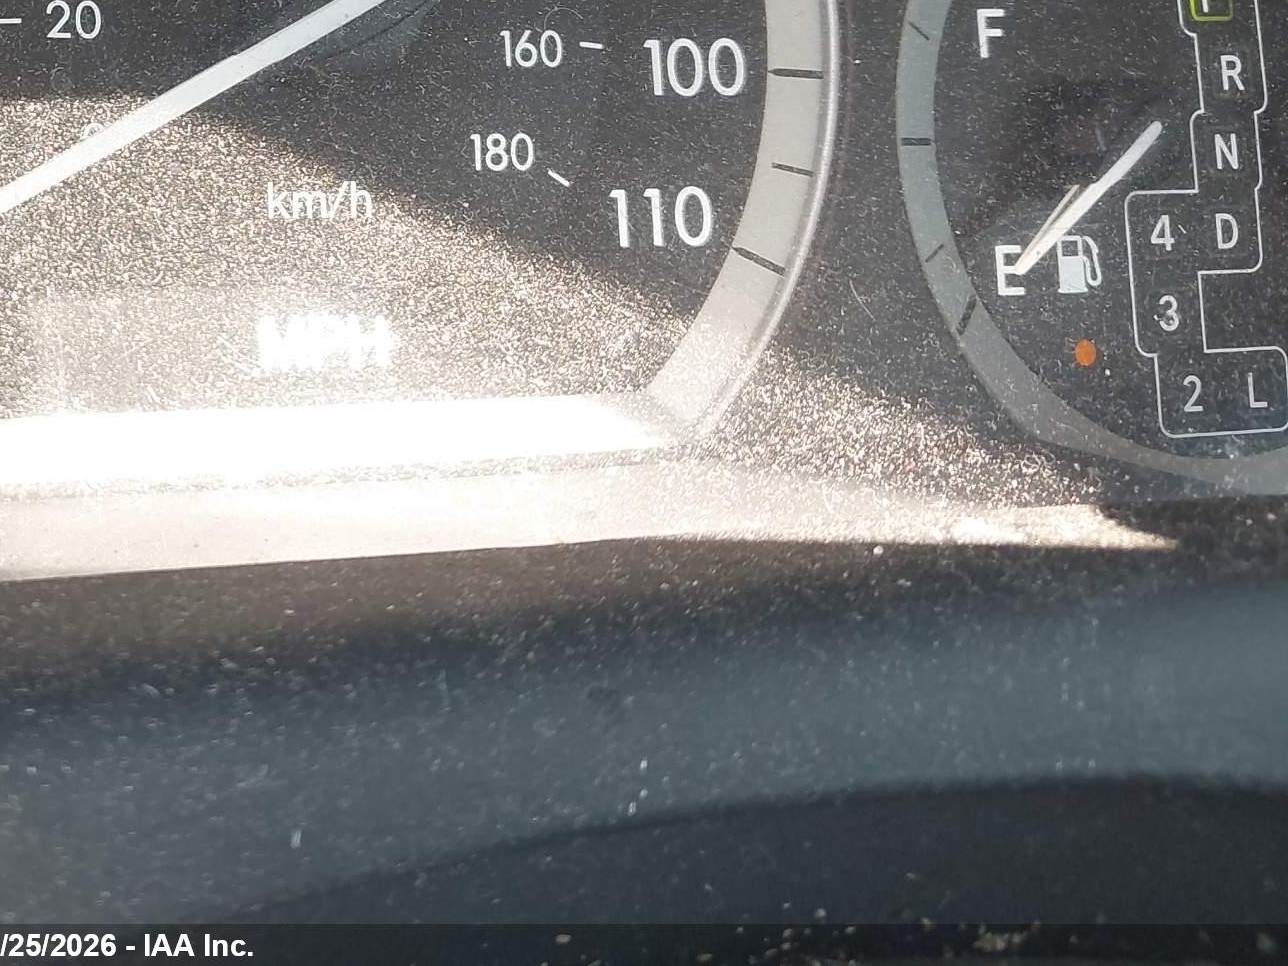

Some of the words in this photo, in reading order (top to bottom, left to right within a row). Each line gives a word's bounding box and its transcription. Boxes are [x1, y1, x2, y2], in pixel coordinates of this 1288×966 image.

[45, 0, 102, 39] 20
[977, 8, 1006, 58] F
[500, 30, 563, 68] 160
[643, 37, 746, 96] 100
[1219, 54, 1246, 91] R
[470, 133, 535, 172] 180
[1214, 133, 1240, 170] N
[266, 180, 373, 221] km/h
[609, 185, 713, 248] 110
[1149, 214, 1175, 252] 4
[1215, 213, 1240, 251] D
[995, 244, 1026, 297] E
[1154, 295, 1181, 332] 3
[258, 313, 396, 371] MPH
[1183, 374, 1203, 412] 2
[1246, 371, 1268, 409] L
